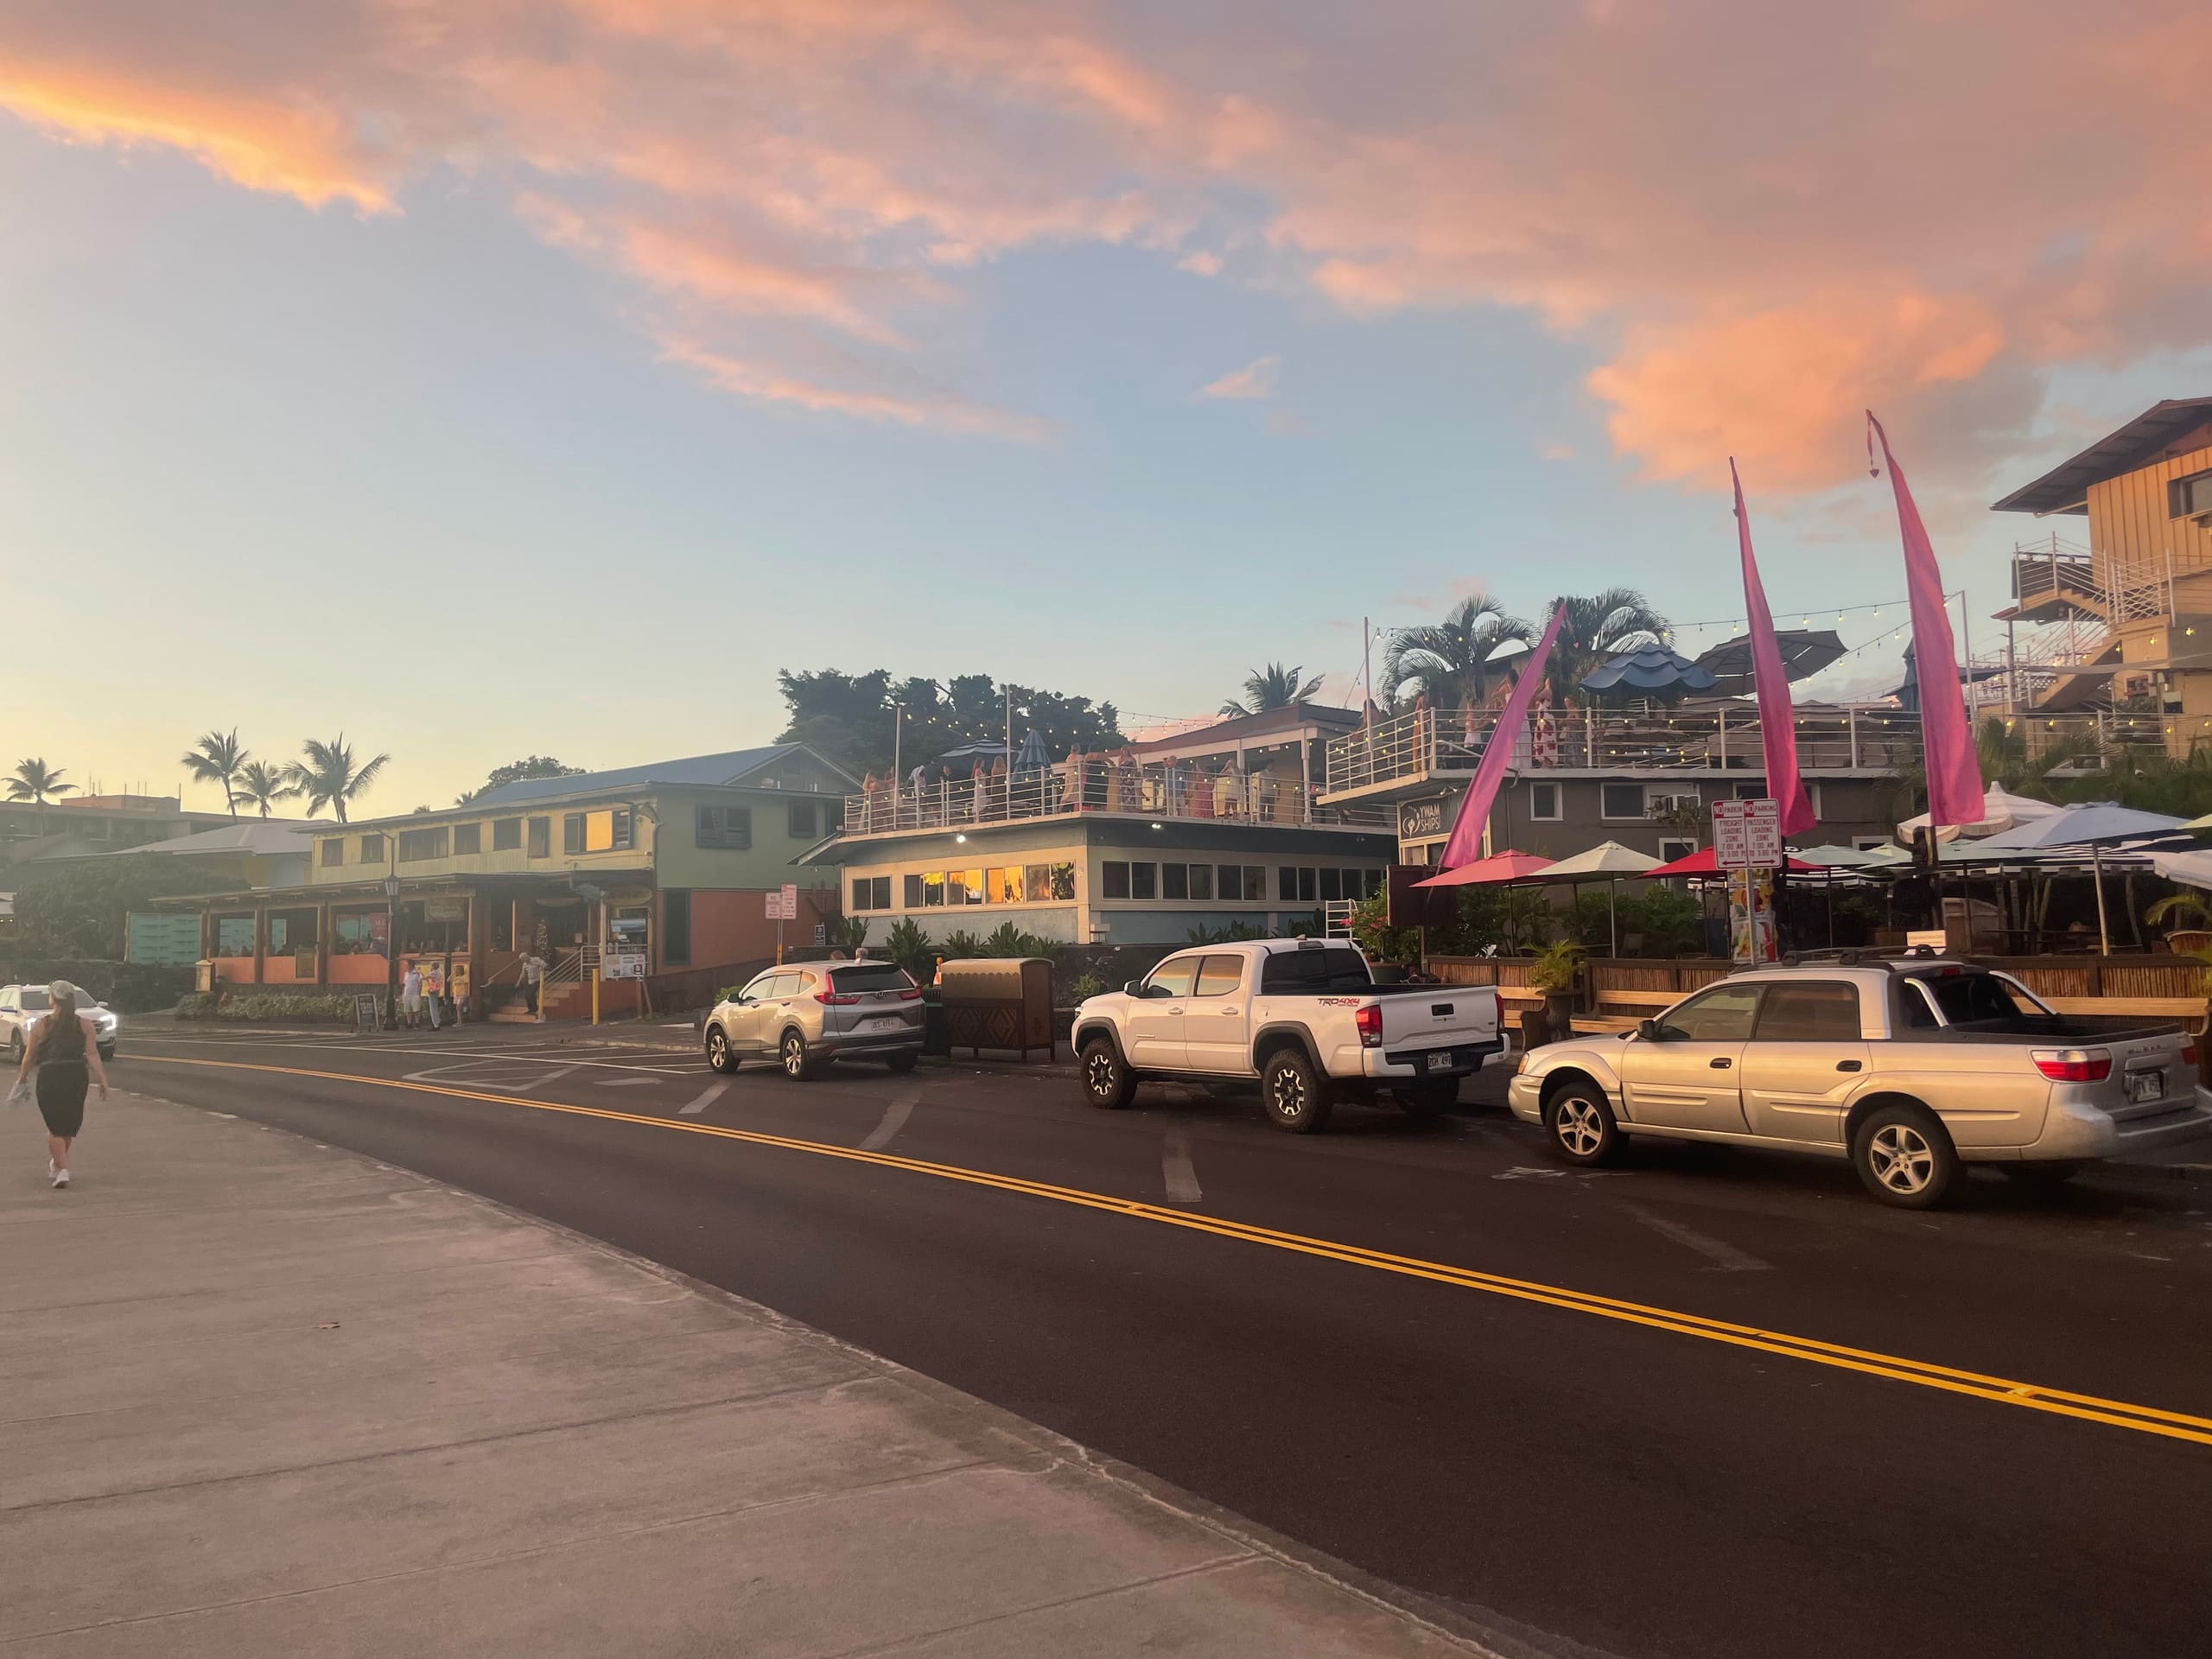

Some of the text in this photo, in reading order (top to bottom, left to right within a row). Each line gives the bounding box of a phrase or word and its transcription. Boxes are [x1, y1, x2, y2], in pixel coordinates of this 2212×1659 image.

[1419, 803, 1440, 818] YWAM
[1714, 805, 1723, 815] NO
[1744, 804, 1754, 814] NO
[1421, 817, 1439, 831] SHIPS
